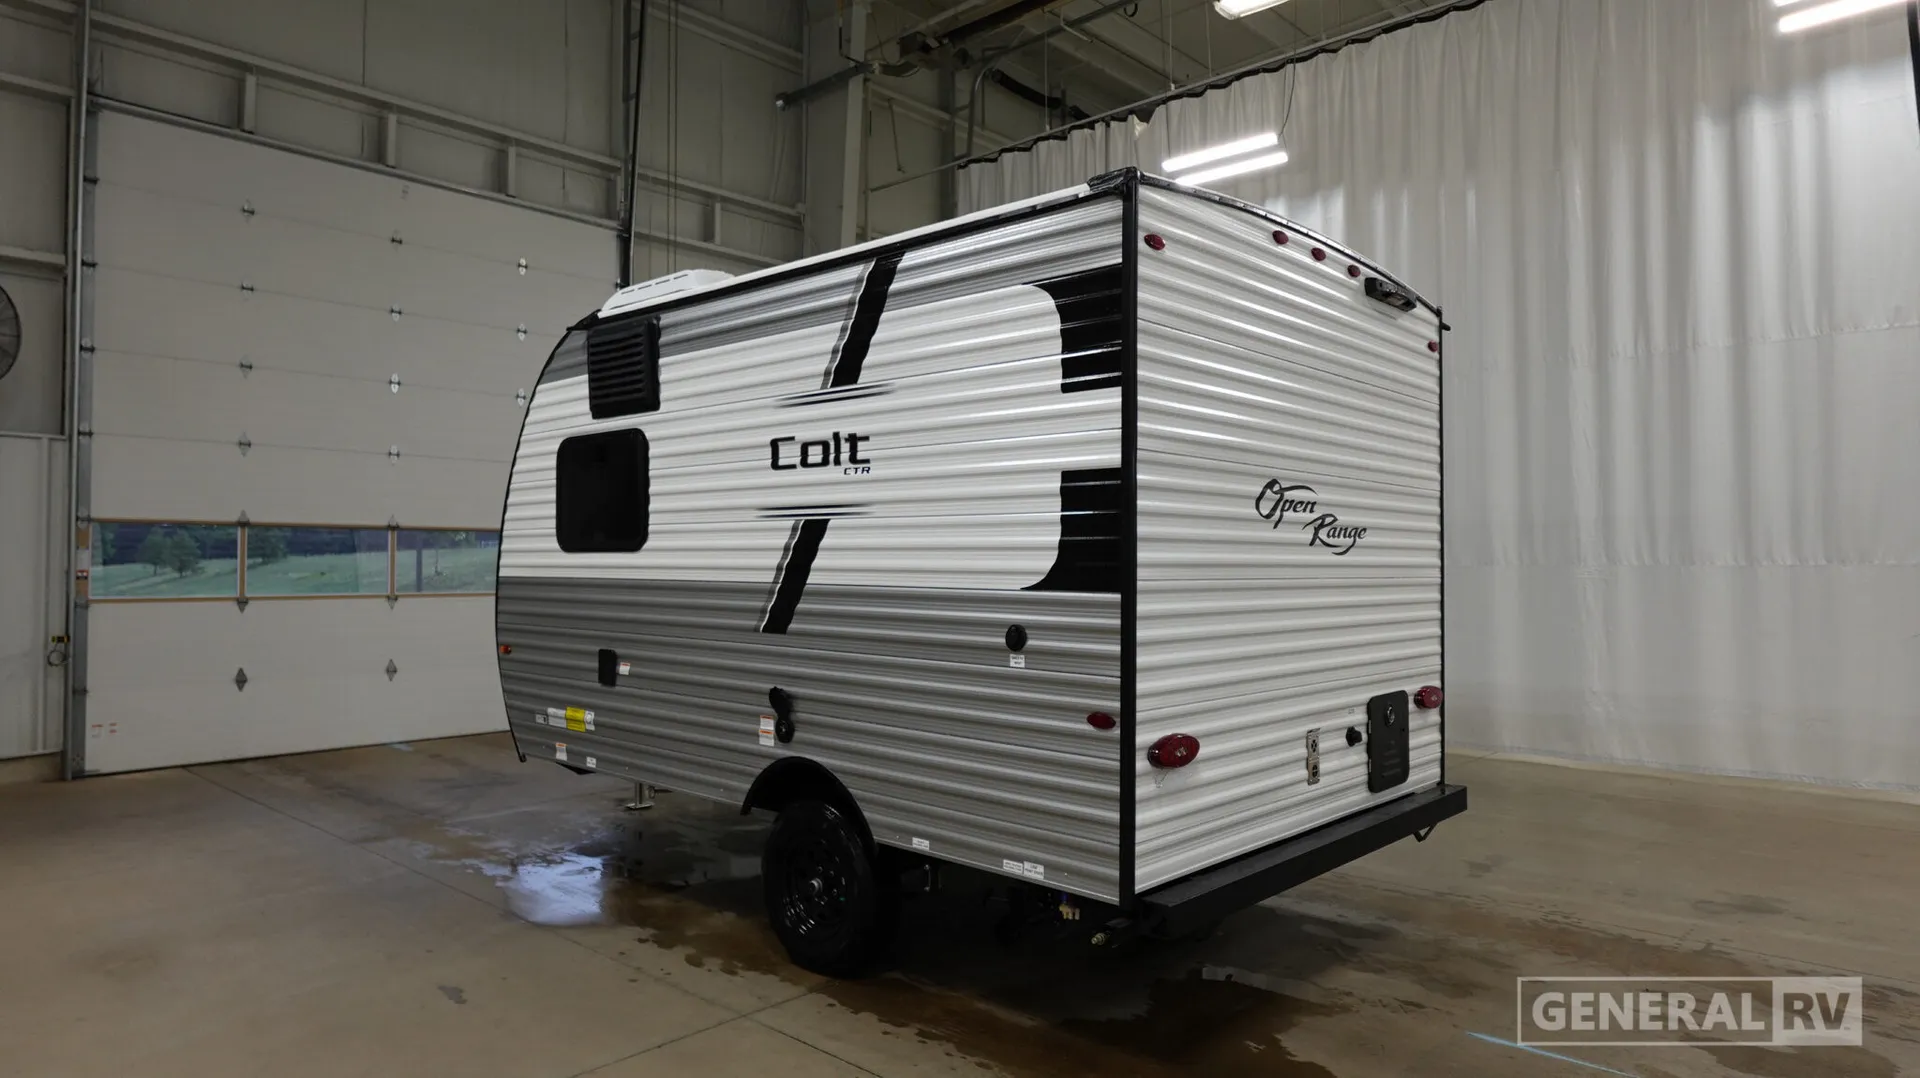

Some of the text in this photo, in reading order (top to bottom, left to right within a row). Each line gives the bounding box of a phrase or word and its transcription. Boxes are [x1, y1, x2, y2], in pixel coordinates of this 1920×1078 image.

[770, 431, 871, 471] Colt
[843, 466, 871, 476] CTR
[1255, 478, 1319, 530] Open
[1302, 513, 1368, 556] Range
